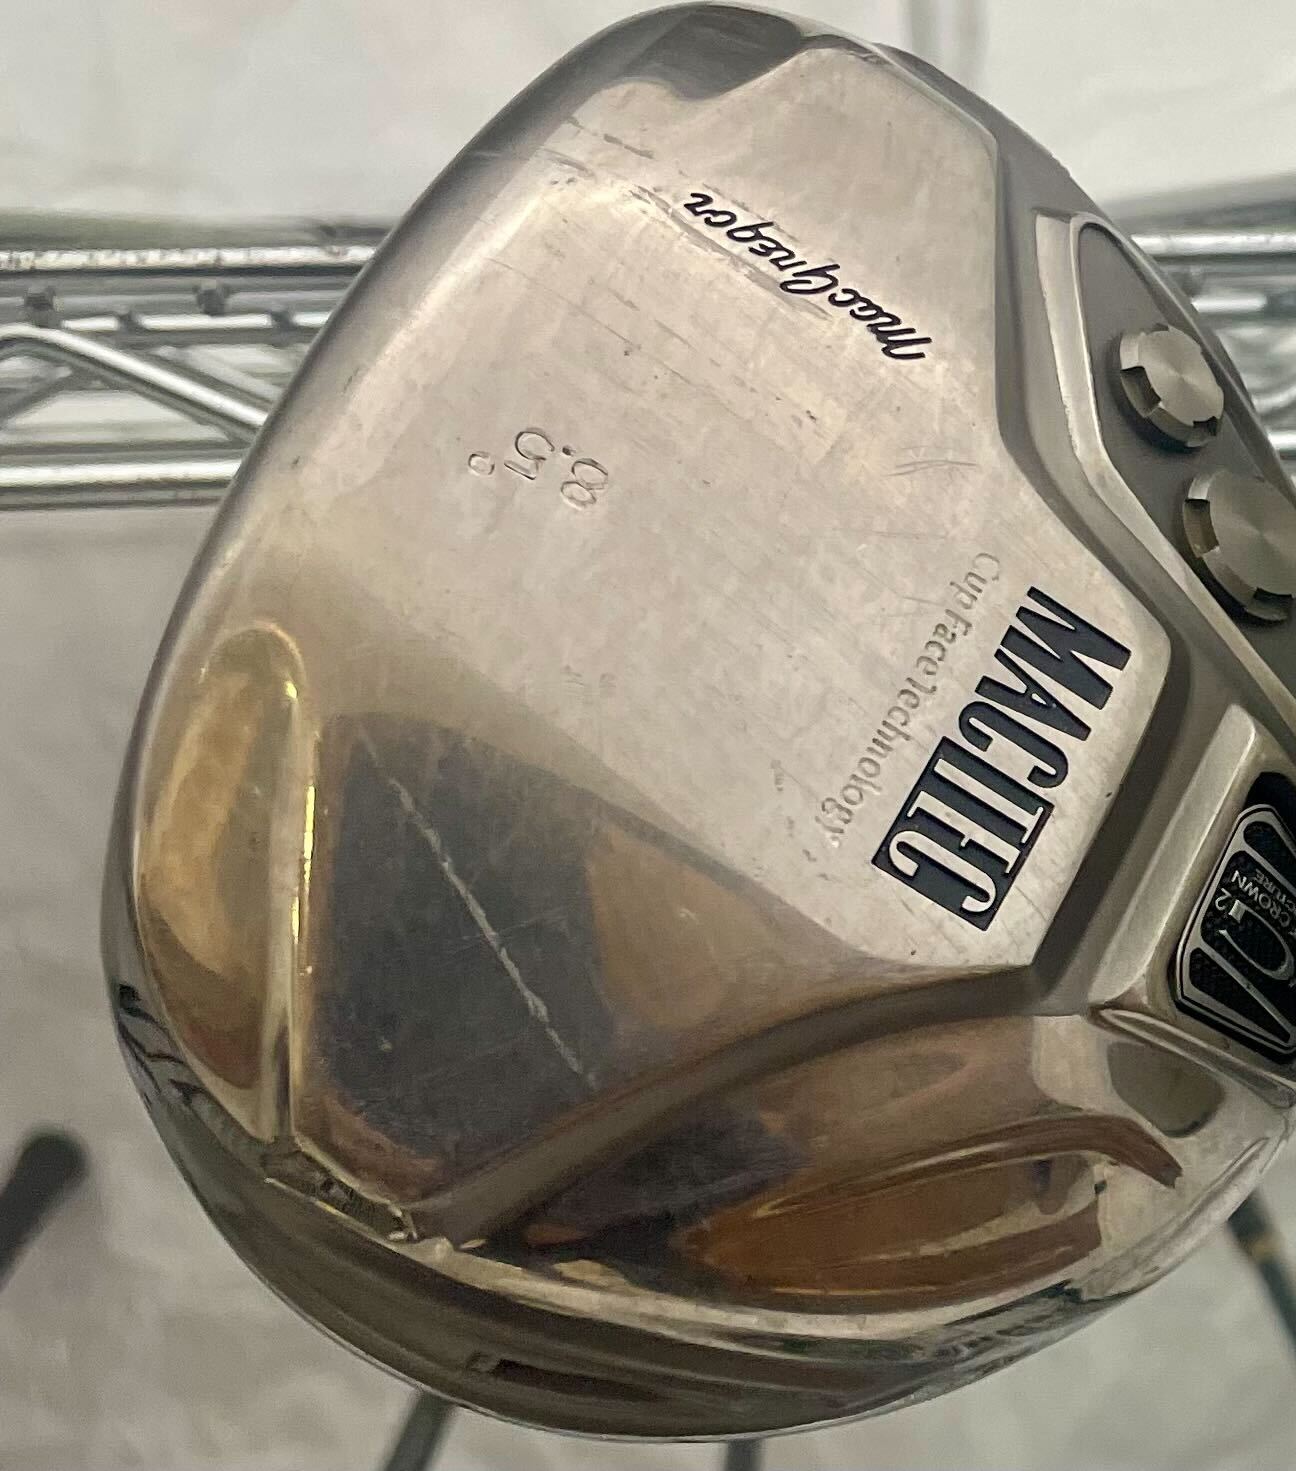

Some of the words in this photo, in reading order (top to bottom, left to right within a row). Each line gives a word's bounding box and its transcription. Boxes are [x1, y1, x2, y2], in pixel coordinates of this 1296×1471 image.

[684, 192, 933, 360] MacGregor
[950, 552, 1001, 611] Cup
[916, 609, 973, 676] Face
[814, 677, 937, 848] Technology
[886, 586, 1132, 916] MACTEC
[1231, 870, 1291, 928] CROWN
